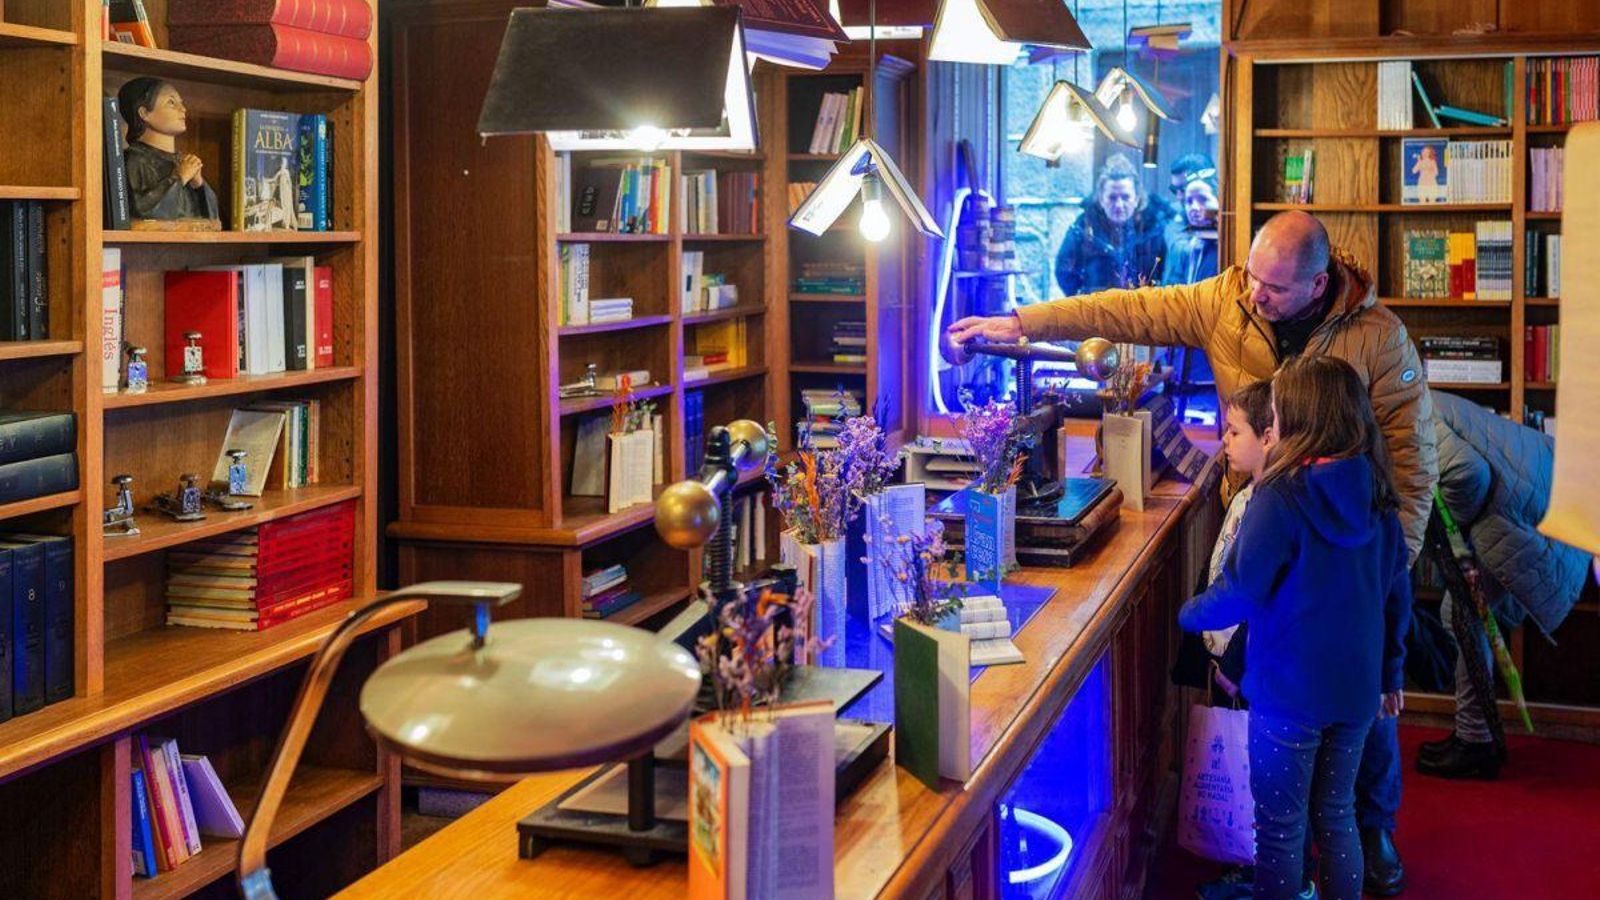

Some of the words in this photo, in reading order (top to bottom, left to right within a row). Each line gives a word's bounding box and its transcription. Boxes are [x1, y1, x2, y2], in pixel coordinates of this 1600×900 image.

[254, 130, 293, 150] ALBA
[103, 308, 118, 361] Inglés
[28, 588, 35, 600] 8
